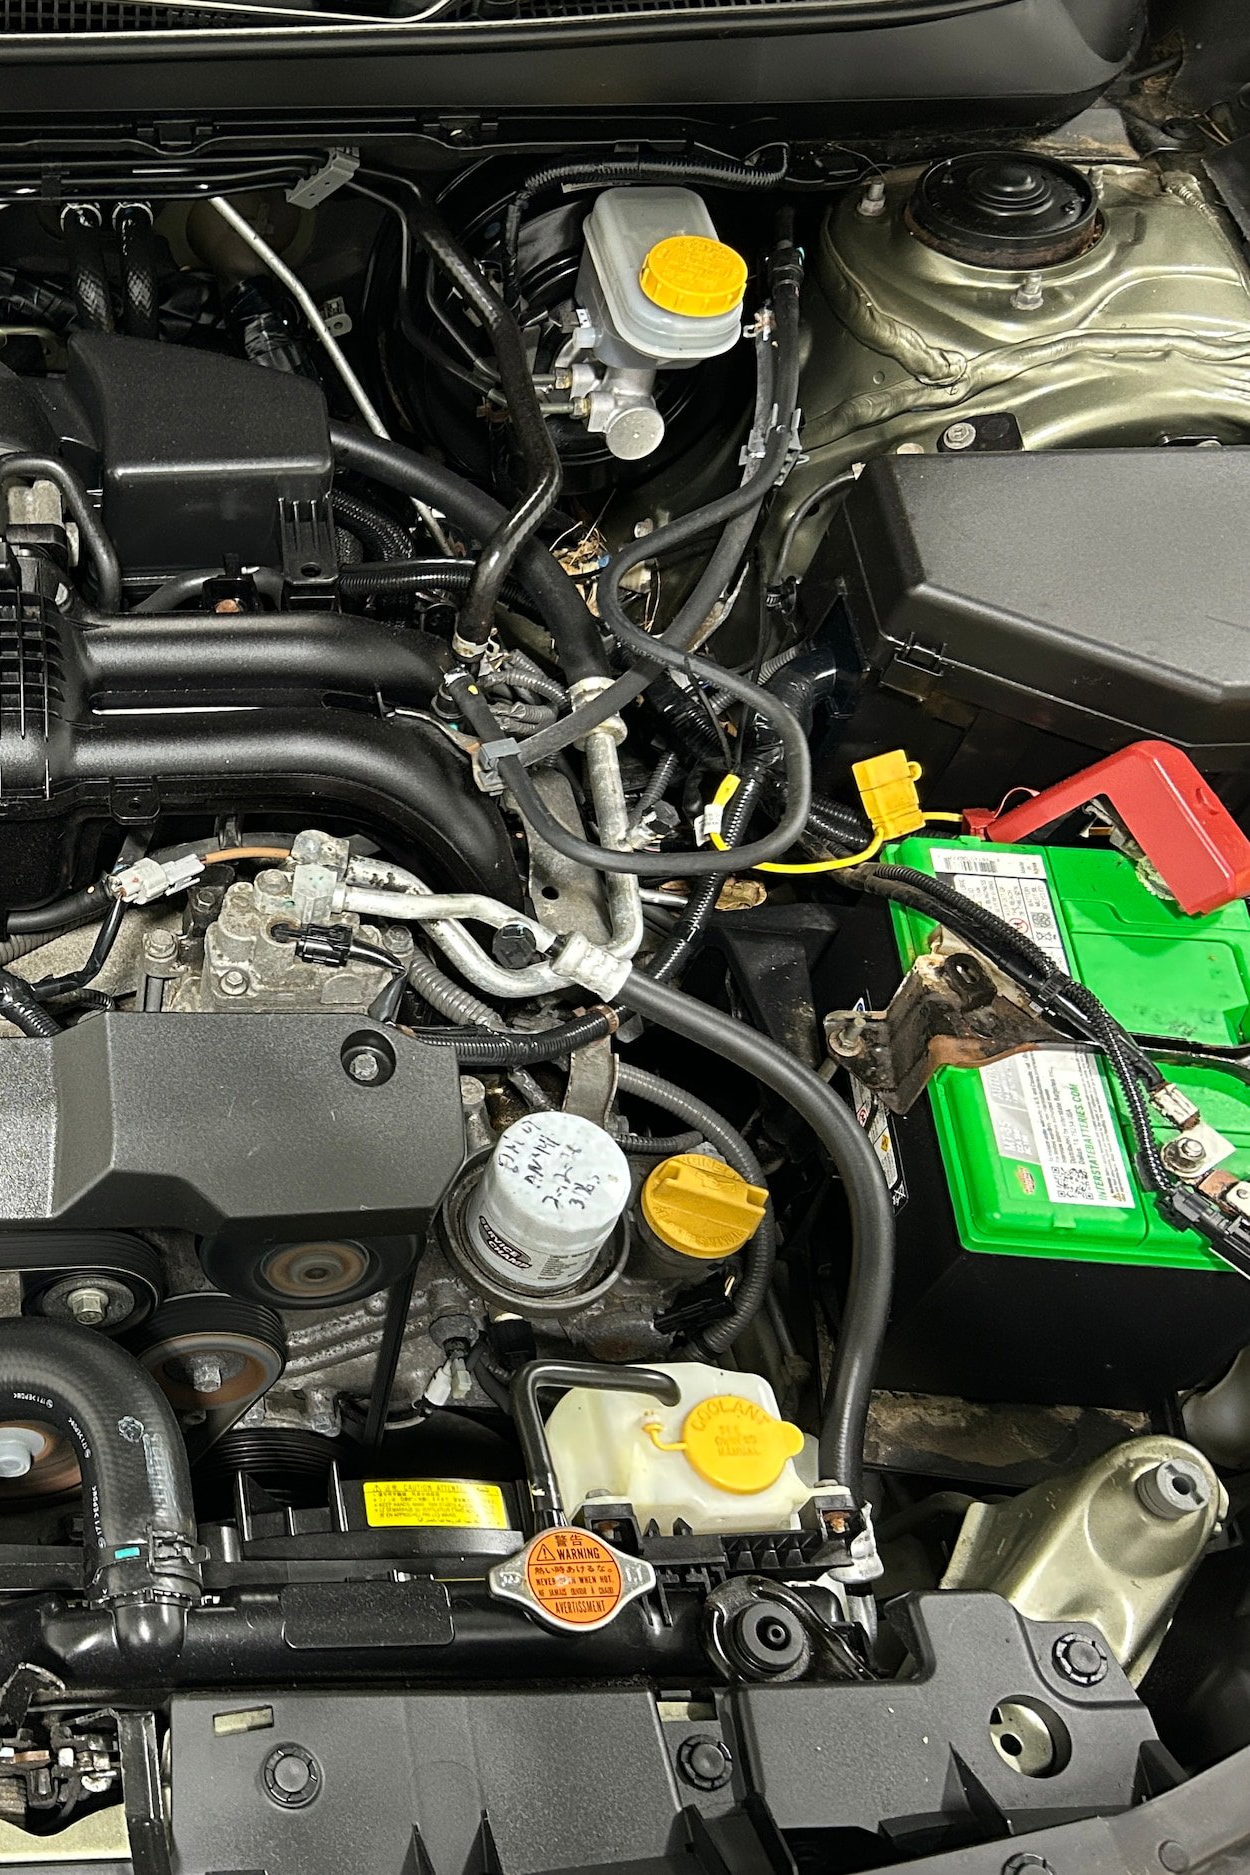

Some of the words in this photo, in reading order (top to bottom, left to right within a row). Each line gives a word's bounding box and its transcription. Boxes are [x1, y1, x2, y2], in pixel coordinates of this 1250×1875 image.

[488, 1240, 530, 1269] CHAMP
[690, 1399, 771, 1431] COOLANT
[554, 1534, 583, 1547] 警告
[556, 1548, 600, 1560] WARNING
[535, 1577, 556, 1586] NEVER
[578, 1575, 597, 1584] WHEN
